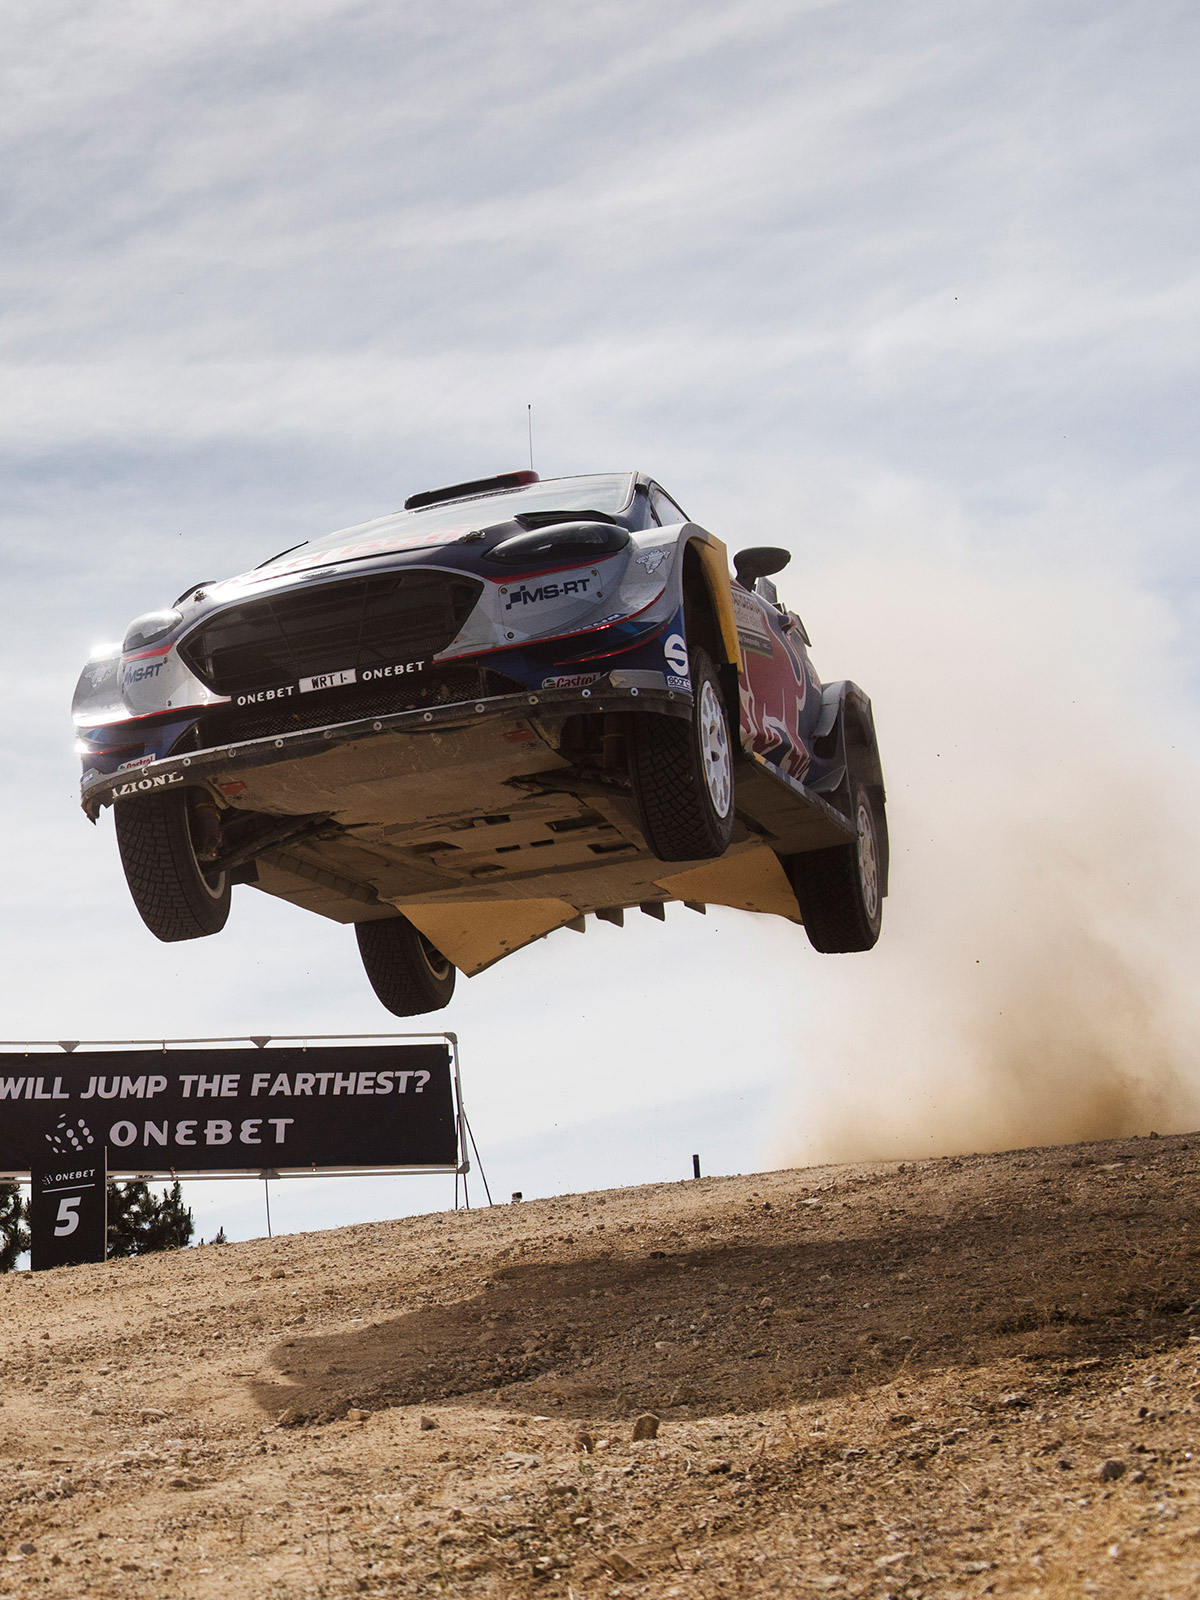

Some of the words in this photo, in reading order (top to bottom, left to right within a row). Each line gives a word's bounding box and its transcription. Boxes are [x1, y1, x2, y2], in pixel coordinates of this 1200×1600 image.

[522, 578, 591, 606] MS-RT
[237, 685, 295, 706] ONEBET
[312, 673, 336, 690] WRT
[362, 660, 426, 682] ONEBET
[556, 673, 597, 689] Castrol
[80, 1075, 168, 1100] JUMP
[179, 1073, 240, 1098] THE
[250, 1069, 431, 1097] FARTHEST?
[109, 1117, 294, 1146] ONEBET
[55, 1168, 96, 1182] ONEBET
[53, 1196, 82, 1237] 5
